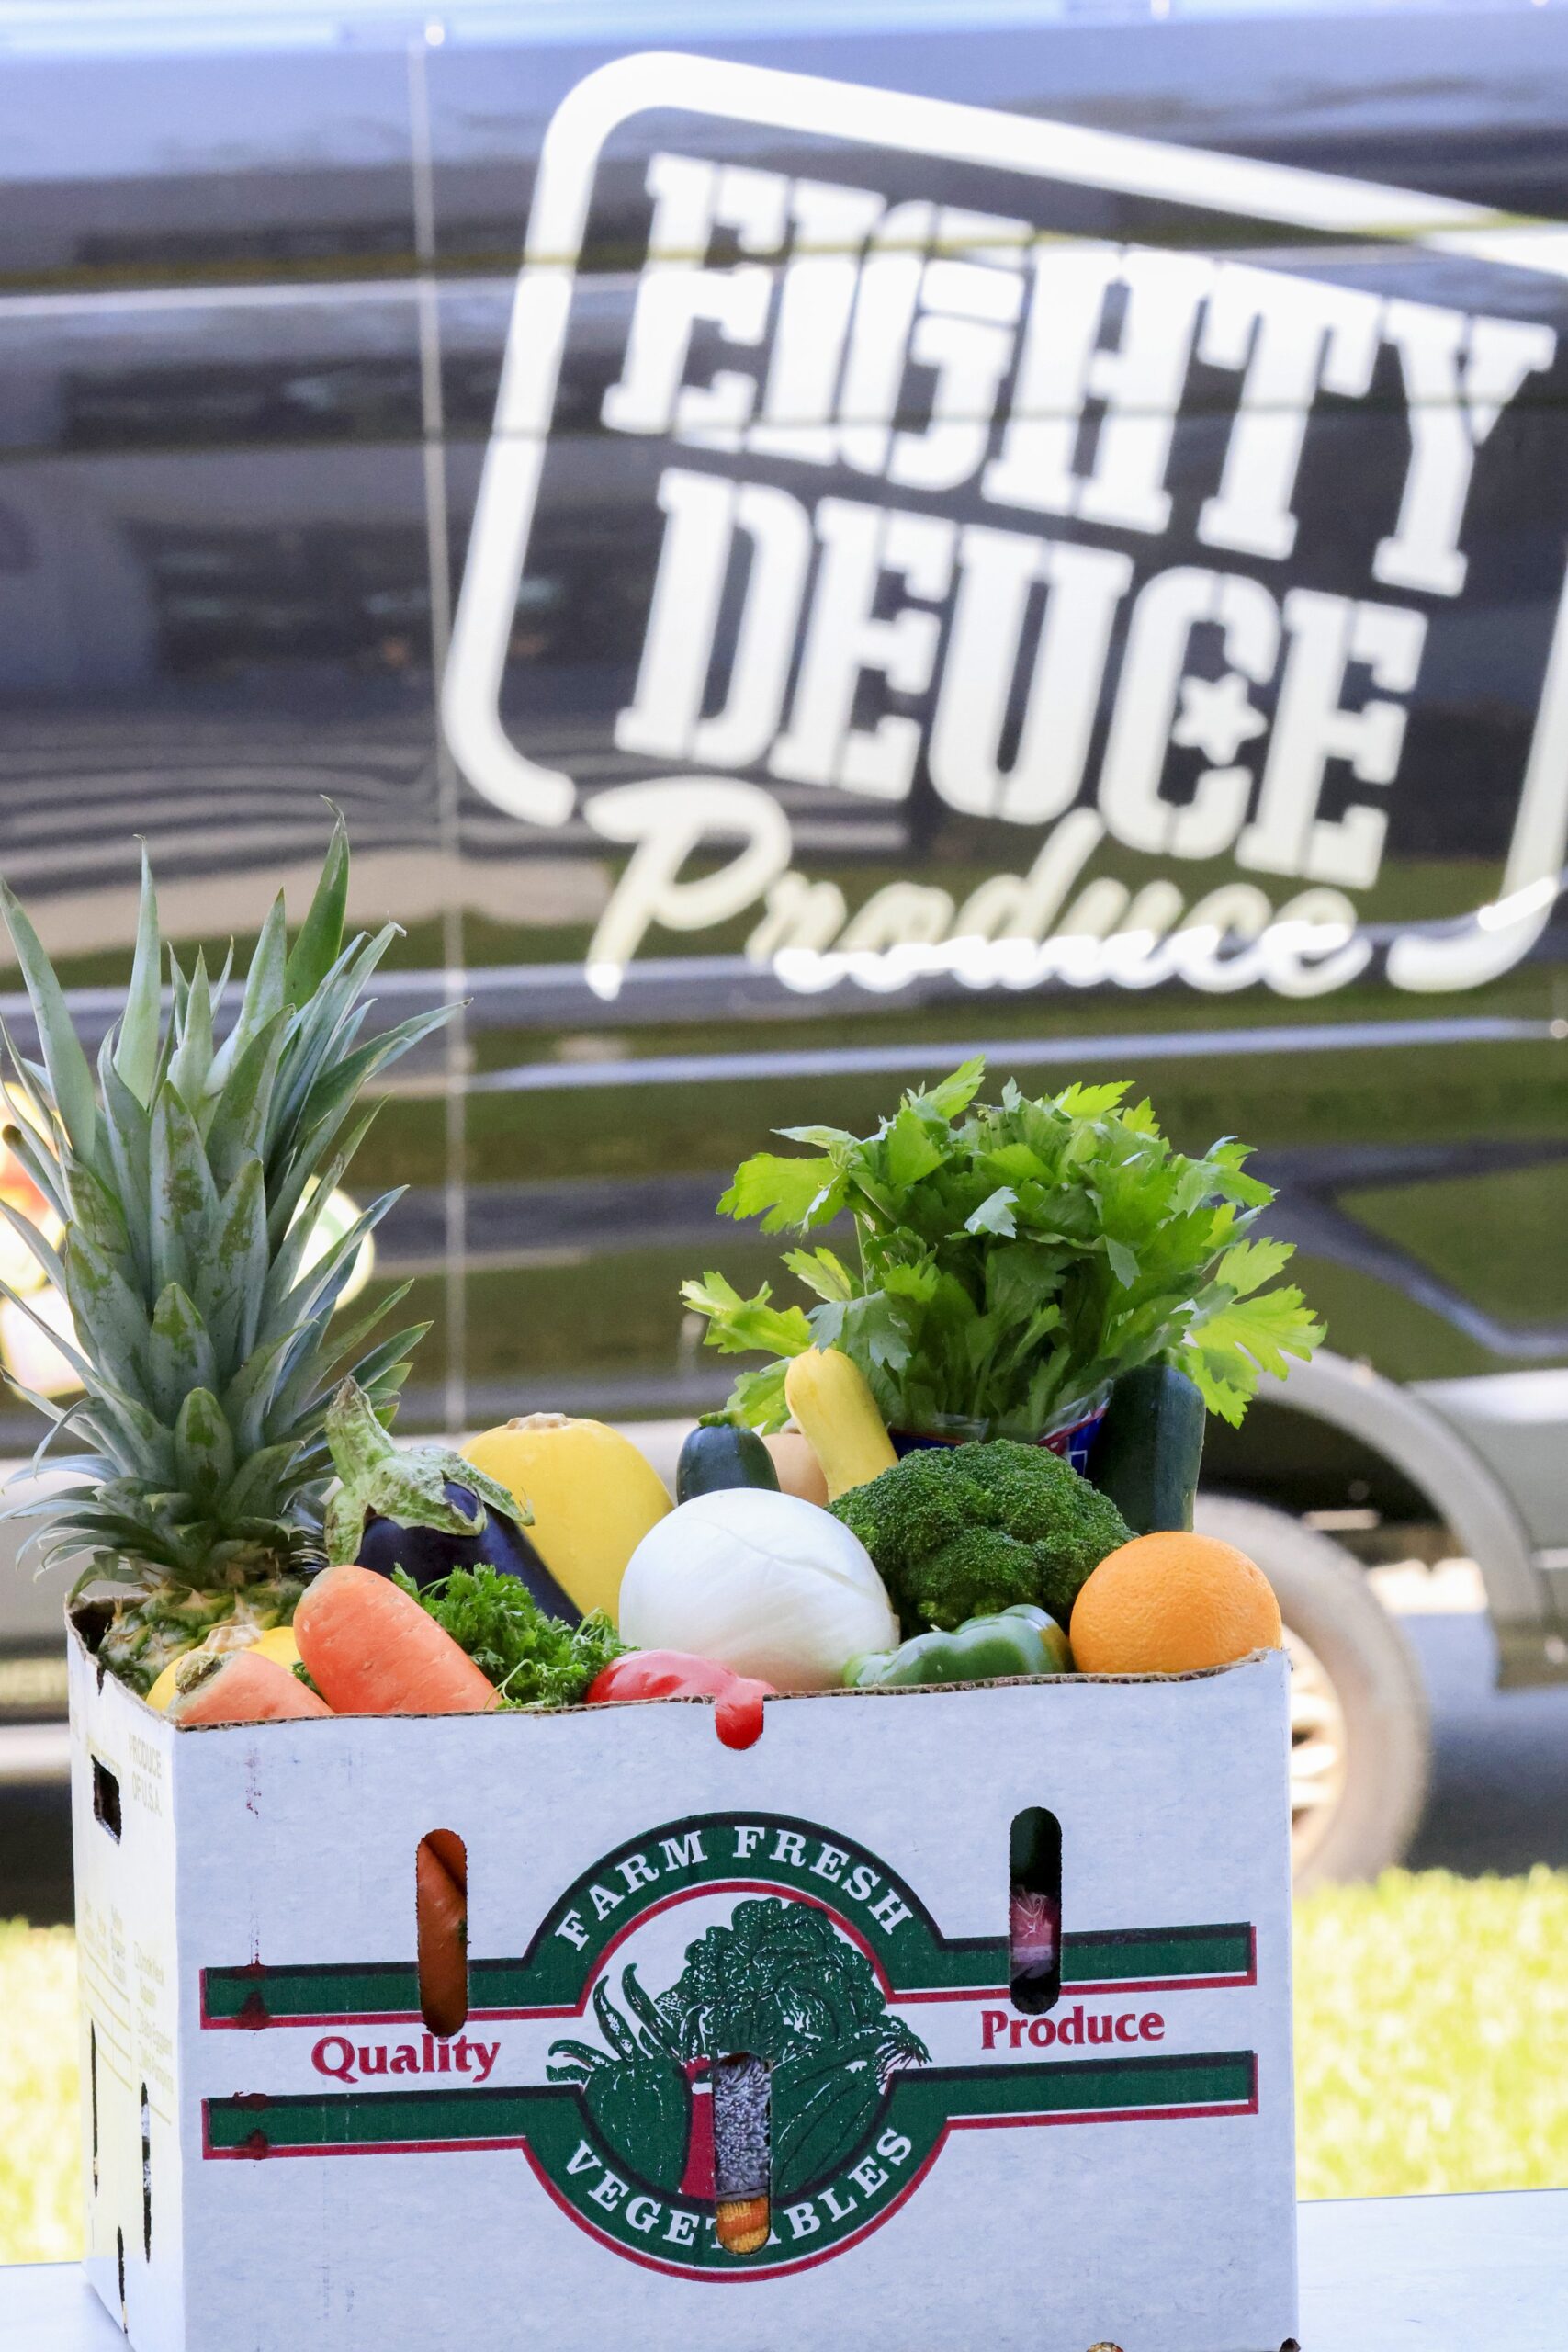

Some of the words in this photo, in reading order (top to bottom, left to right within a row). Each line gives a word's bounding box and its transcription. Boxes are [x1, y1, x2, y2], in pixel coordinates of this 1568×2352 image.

[600, 151, 1558, 597] EIGHTY
[614, 467, 1429, 889] DEUCE
[583, 776, 1372, 1001] Produce
[555, 1831, 709, 1952] FARM
[732, 1825, 915, 1937] FRESH
[310, 2033, 501, 2084] Quality
[981, 2005, 1166, 2051] Produce
[563, 2127, 914, 2249] VEGEBLES
